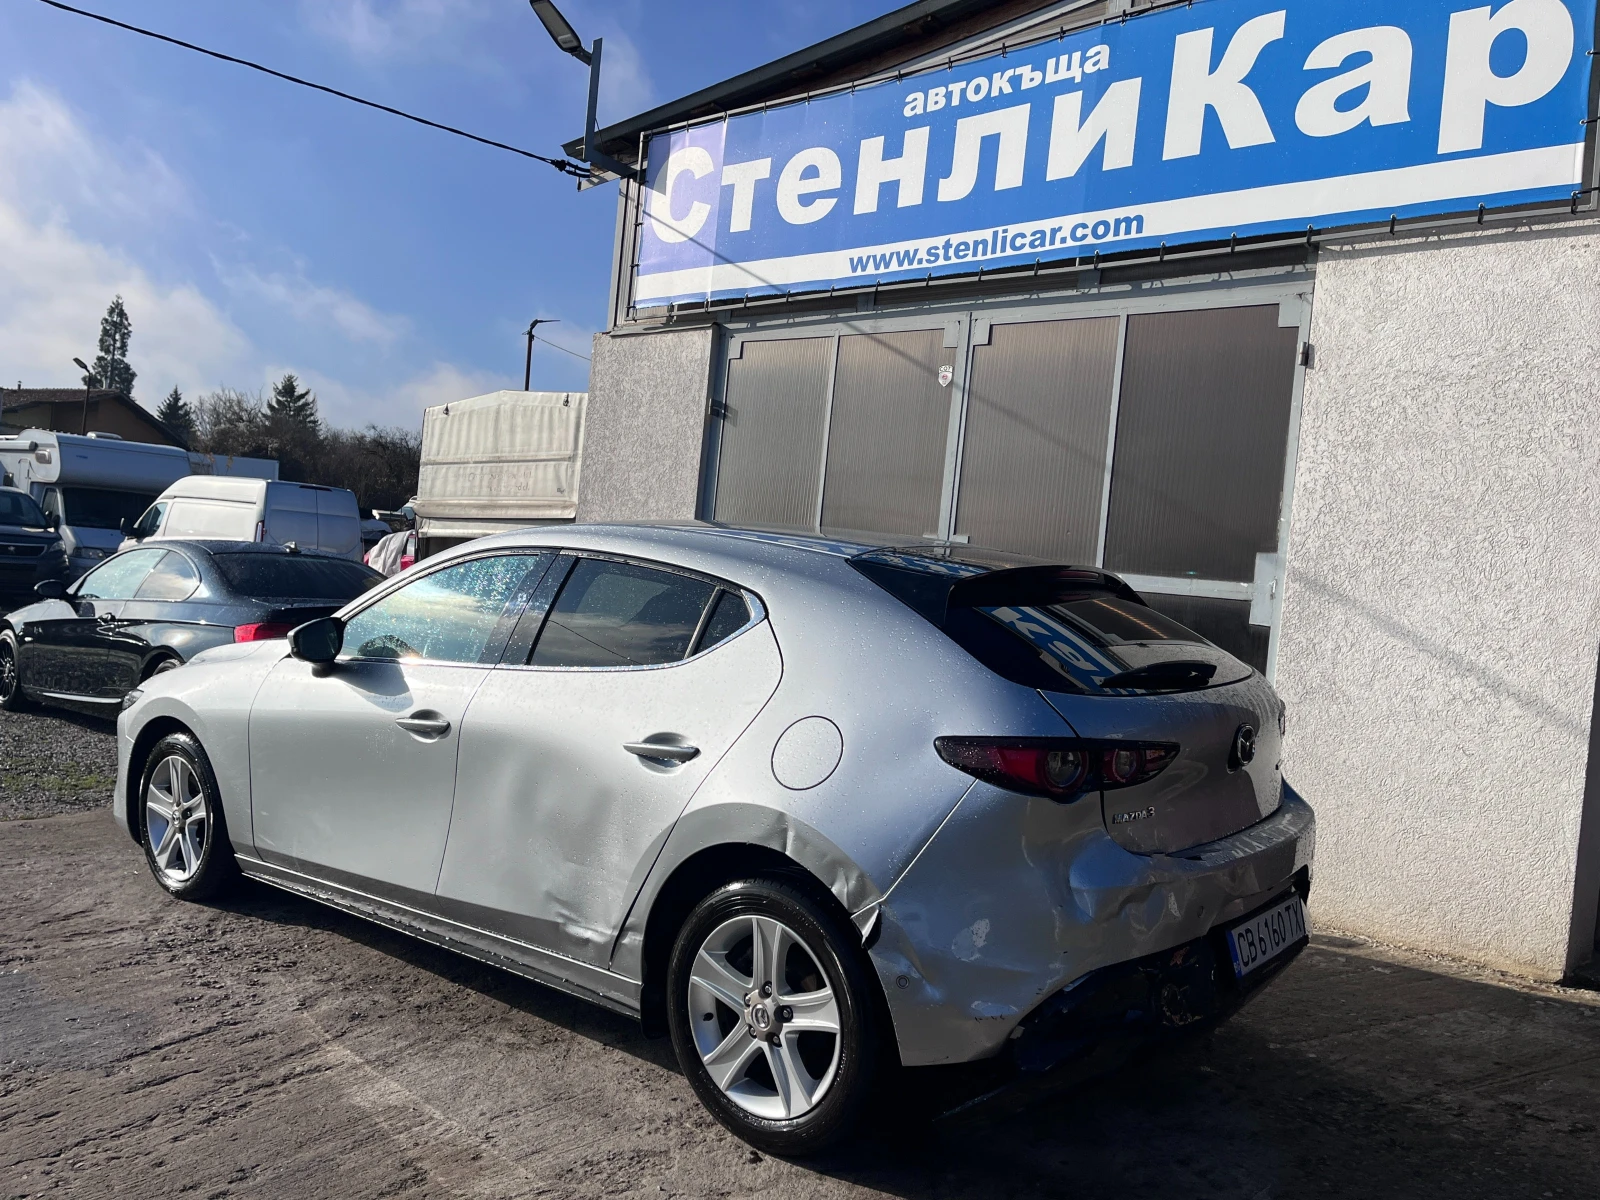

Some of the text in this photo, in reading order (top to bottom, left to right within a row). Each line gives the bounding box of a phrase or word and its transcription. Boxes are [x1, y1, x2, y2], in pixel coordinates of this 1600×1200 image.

[903, 44, 1110, 118] автокъща
[849, 211, 1144, 274] www.stenlicar.com
[1257, 909, 1287, 956] 6160
